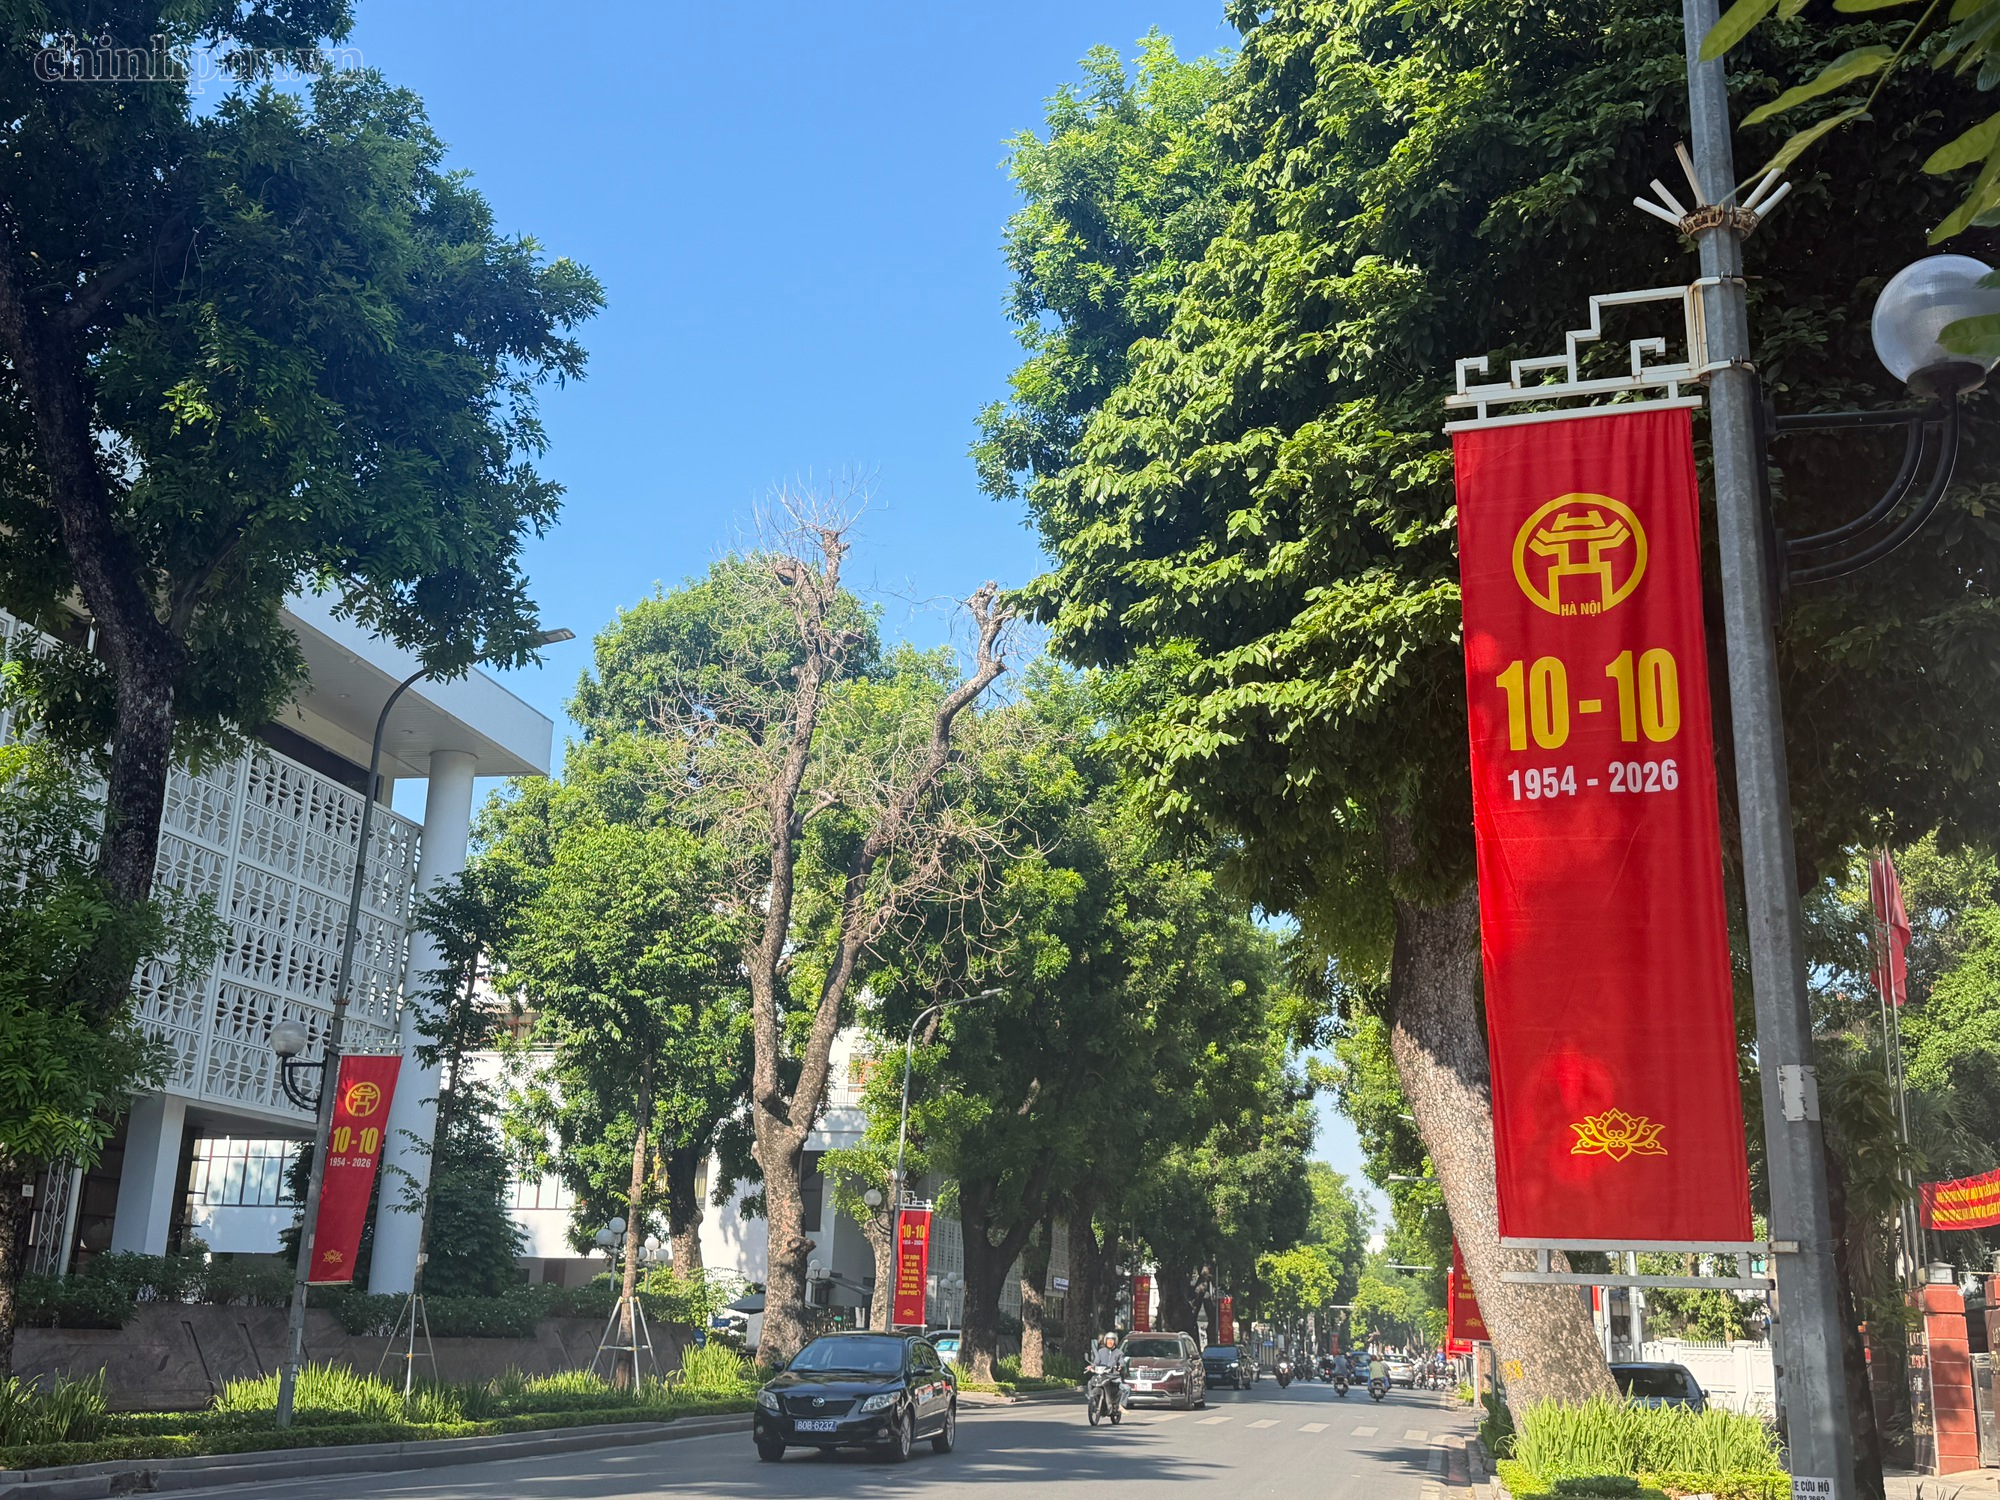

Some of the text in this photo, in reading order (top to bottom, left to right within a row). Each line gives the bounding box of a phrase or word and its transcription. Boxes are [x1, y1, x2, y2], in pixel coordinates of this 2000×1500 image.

[1561, 599, 1601, 617] HÀ NỘI
[1507, 765, 1577, 800] 1954
[1608, 759, 1679, 792] 2026
[330, 1157, 346, 1167] 1954
[352, 1157, 371, 1168] 2026
[1817, 1480, 1830, 1495] HỘ
